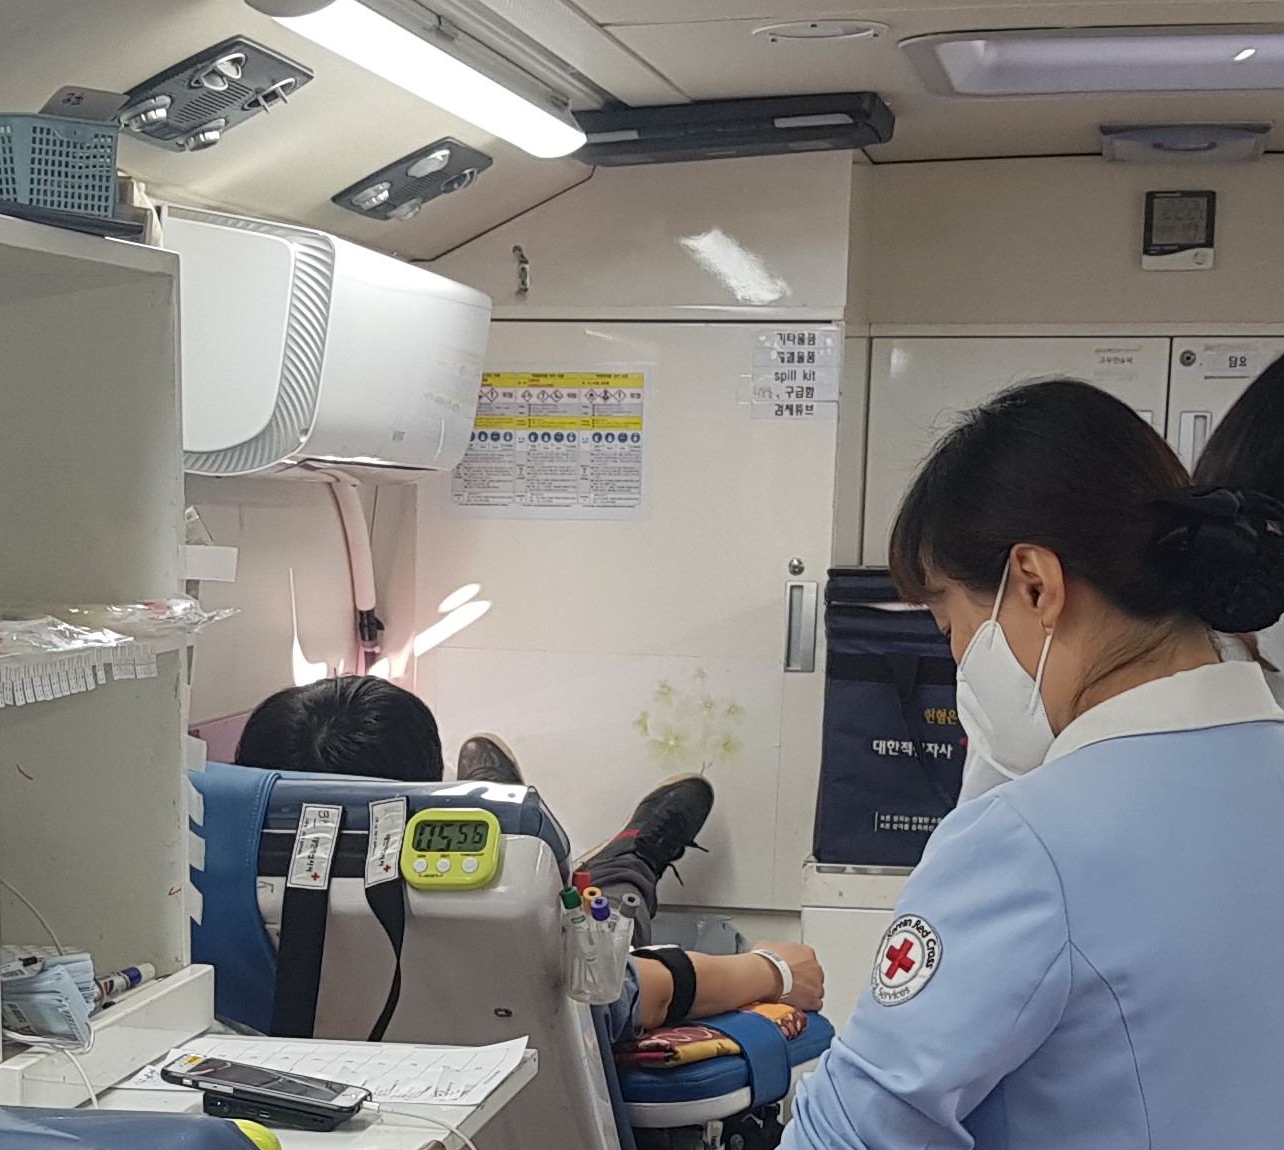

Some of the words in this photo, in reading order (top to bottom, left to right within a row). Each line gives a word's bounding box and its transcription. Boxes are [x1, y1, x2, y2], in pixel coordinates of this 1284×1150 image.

[777, 332, 816, 346] 기타물품
[1228, 356, 1247, 368] 담요
[774, 369, 797, 383] spill
[803, 369, 816, 382] kit
[784, 385, 814, 399] 구급함
[774, 403, 814, 416] 검체튜브
[873, 740, 953, 759] 대한적자사
[926, 938, 937, 969] Cross
